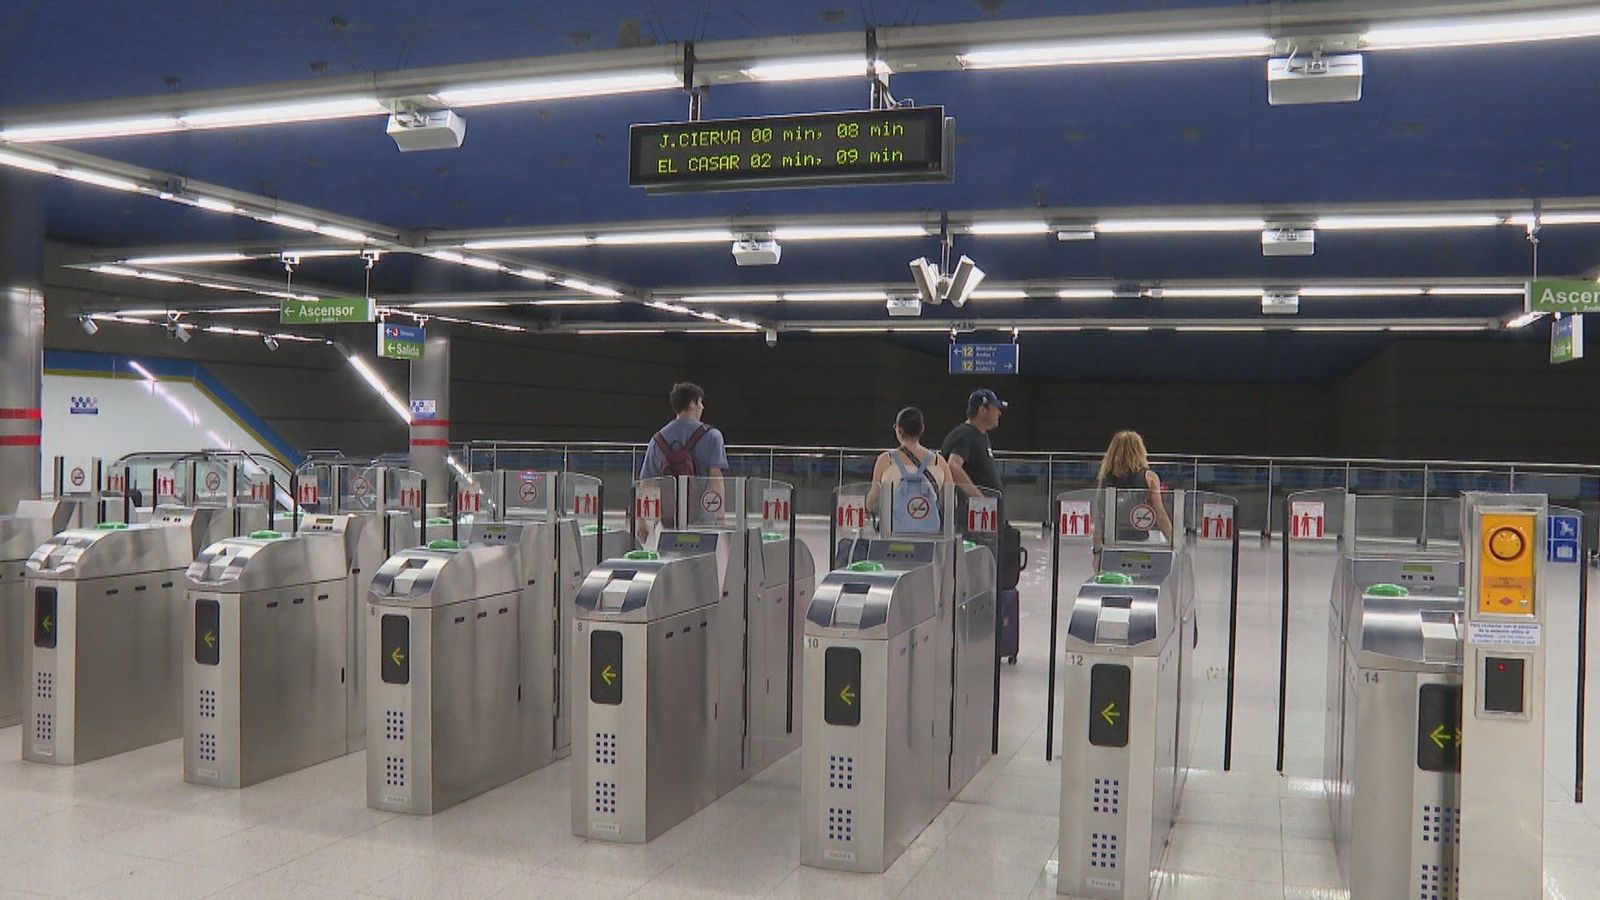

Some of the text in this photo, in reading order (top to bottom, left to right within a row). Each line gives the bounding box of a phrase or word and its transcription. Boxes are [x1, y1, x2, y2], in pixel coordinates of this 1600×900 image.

[659, 120, 904, 150] J.CIERVA 00 min, 08 min
[657, 147, 903, 174] EL CASAR 02 min, 09 min
[298, 305, 355, 317] Ascensor
[396, 343, 420, 357] Salida
[962, 346, 974, 357] 12
[962, 361, 974, 371] 12
[577, 621, 583, 632] 8
[808, 638, 819, 648] 10
[1072, 654, 1083, 666] 12
[1365, 672, 1379, 684] 14
